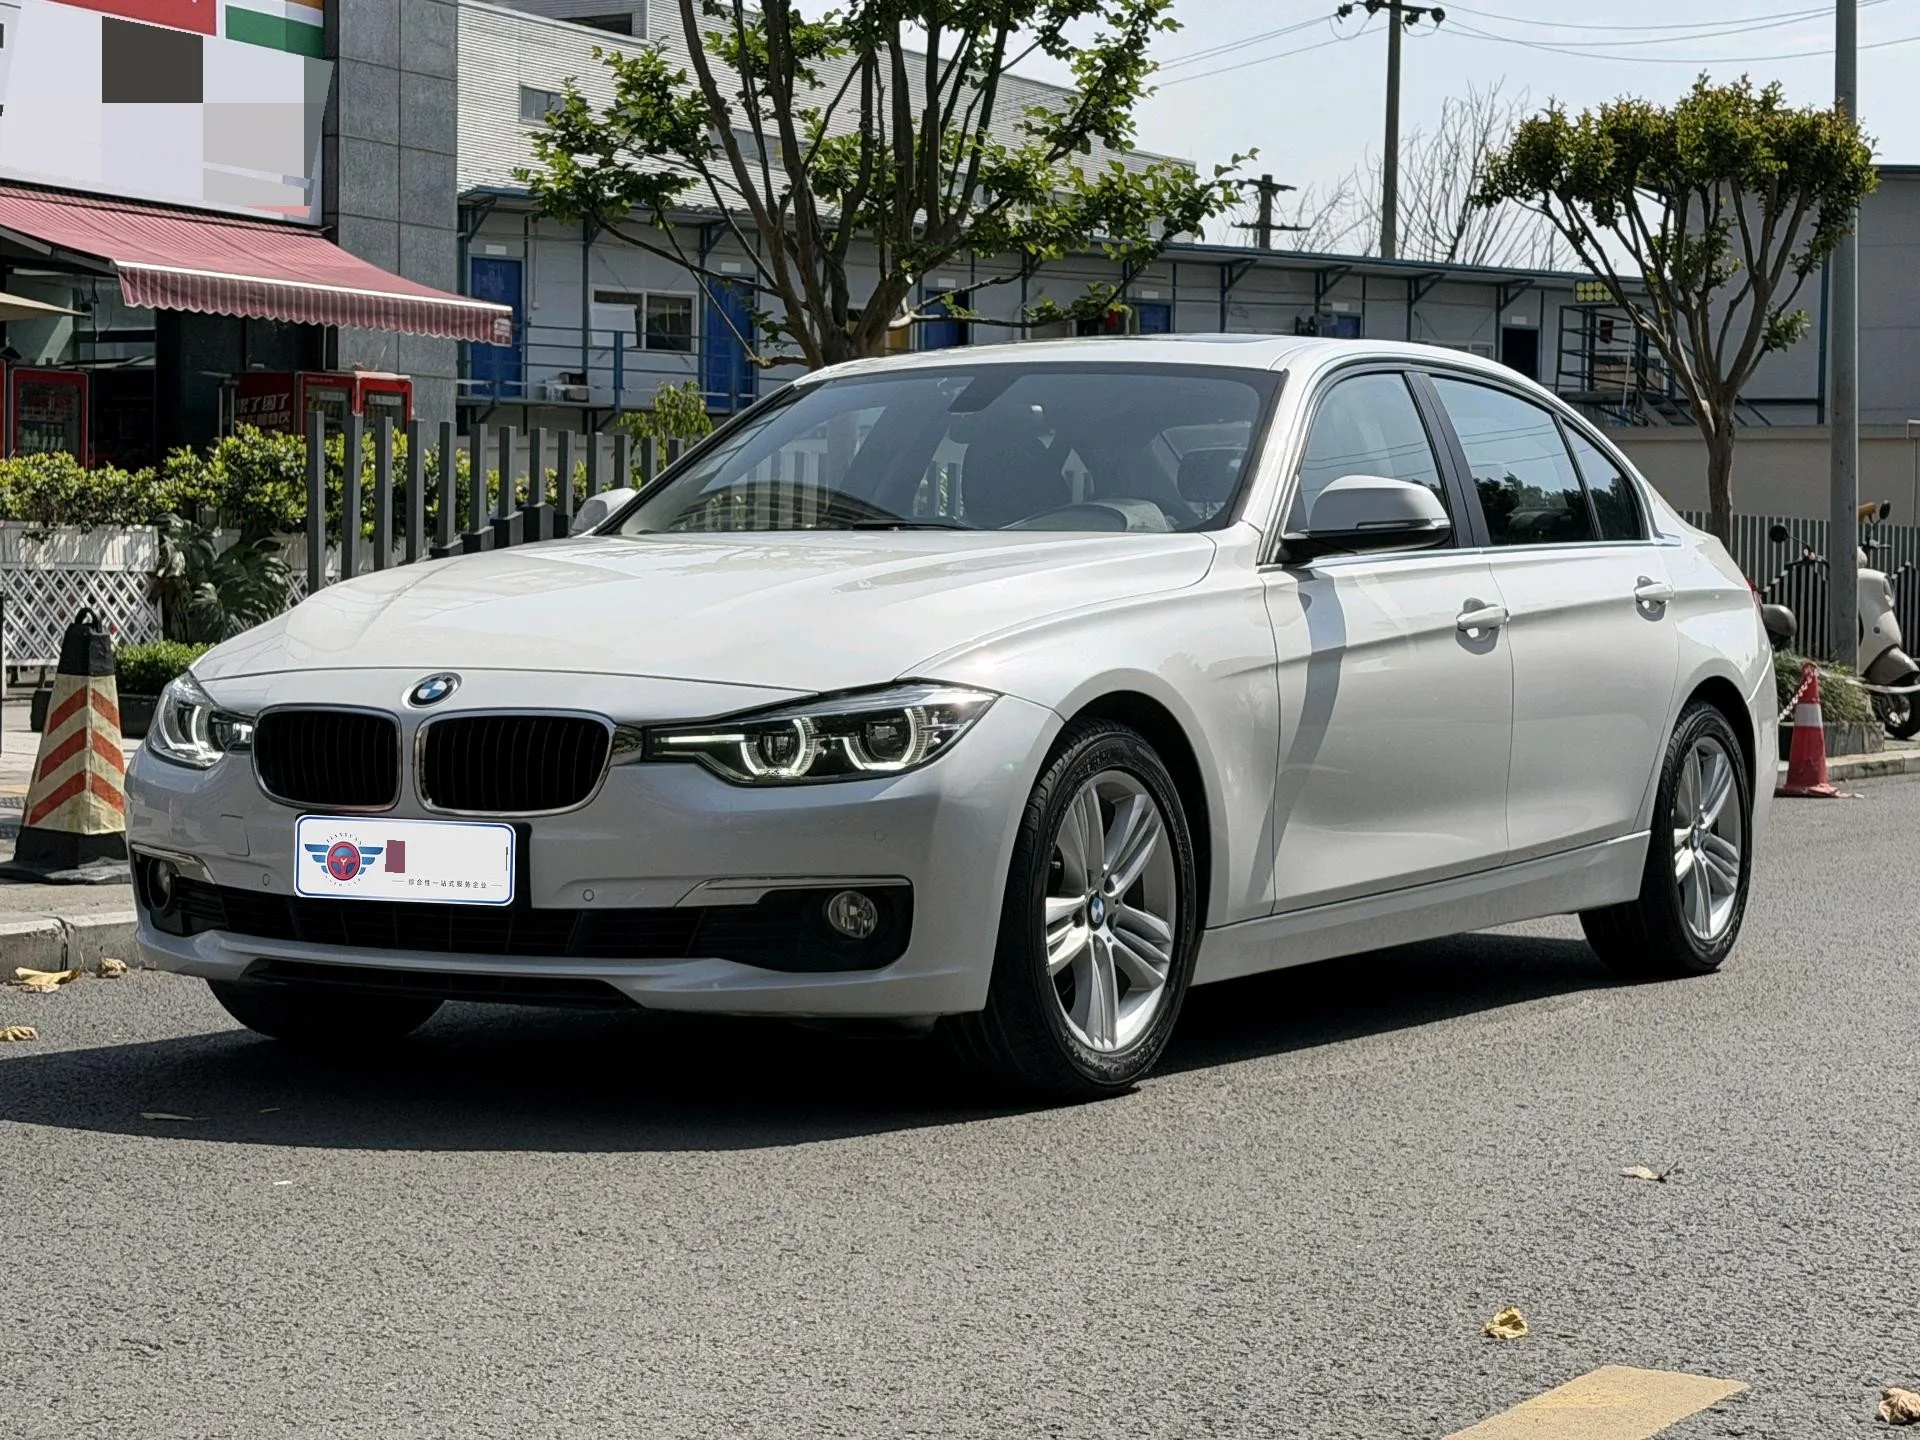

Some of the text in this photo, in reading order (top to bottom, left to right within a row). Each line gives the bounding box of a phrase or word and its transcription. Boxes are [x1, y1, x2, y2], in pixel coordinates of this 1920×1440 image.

[408, 878, 488, 889] 综合性一站式服务企业
